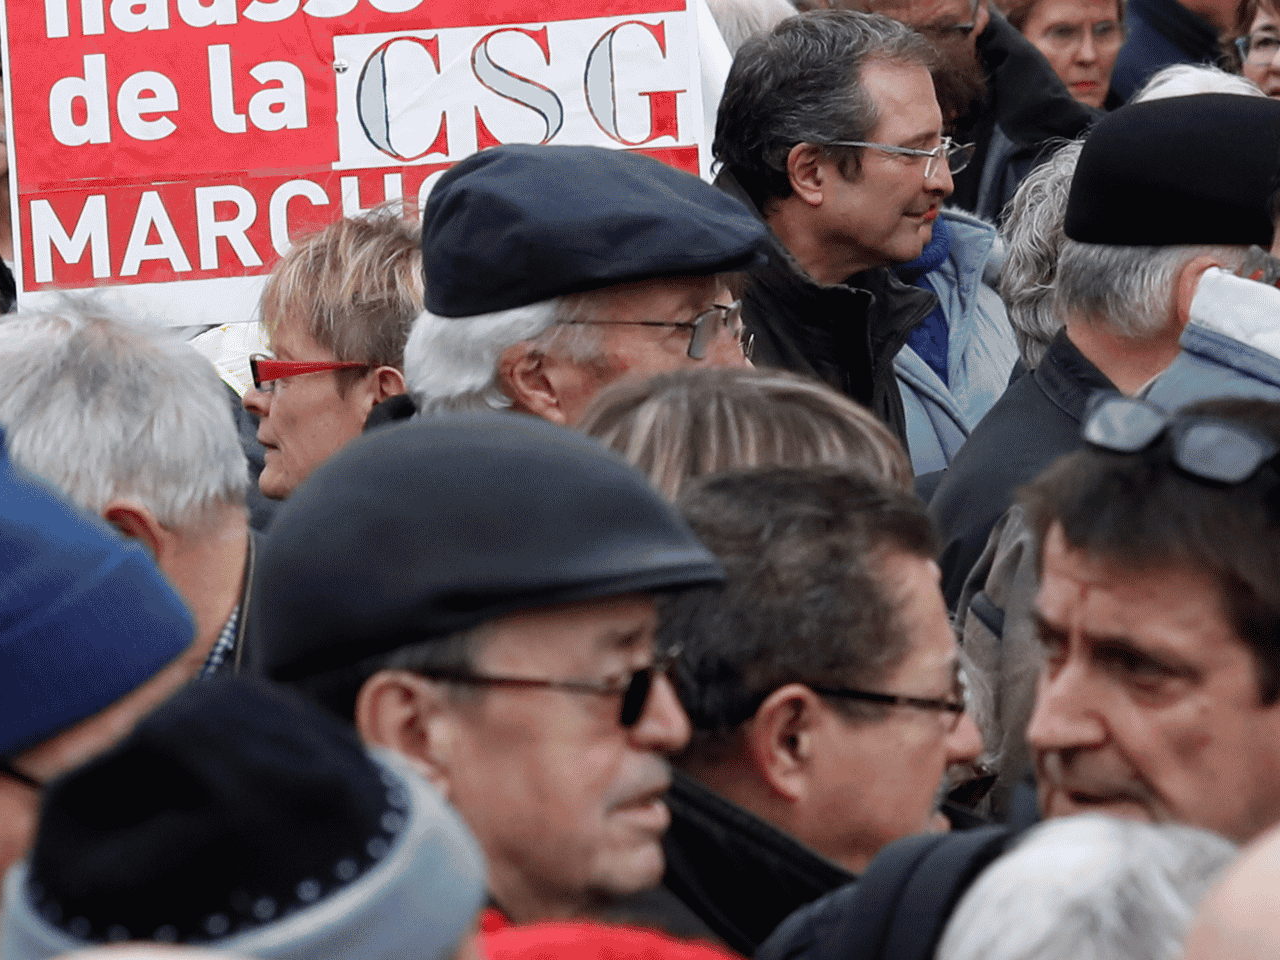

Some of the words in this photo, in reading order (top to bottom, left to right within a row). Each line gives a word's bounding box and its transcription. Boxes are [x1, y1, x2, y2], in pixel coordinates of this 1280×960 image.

[48, 53, 180, 146] de
[207, 43, 309, 134] la
[356, 20, 688, 162] CSG
[29, 169, 444, 283] MARCH
